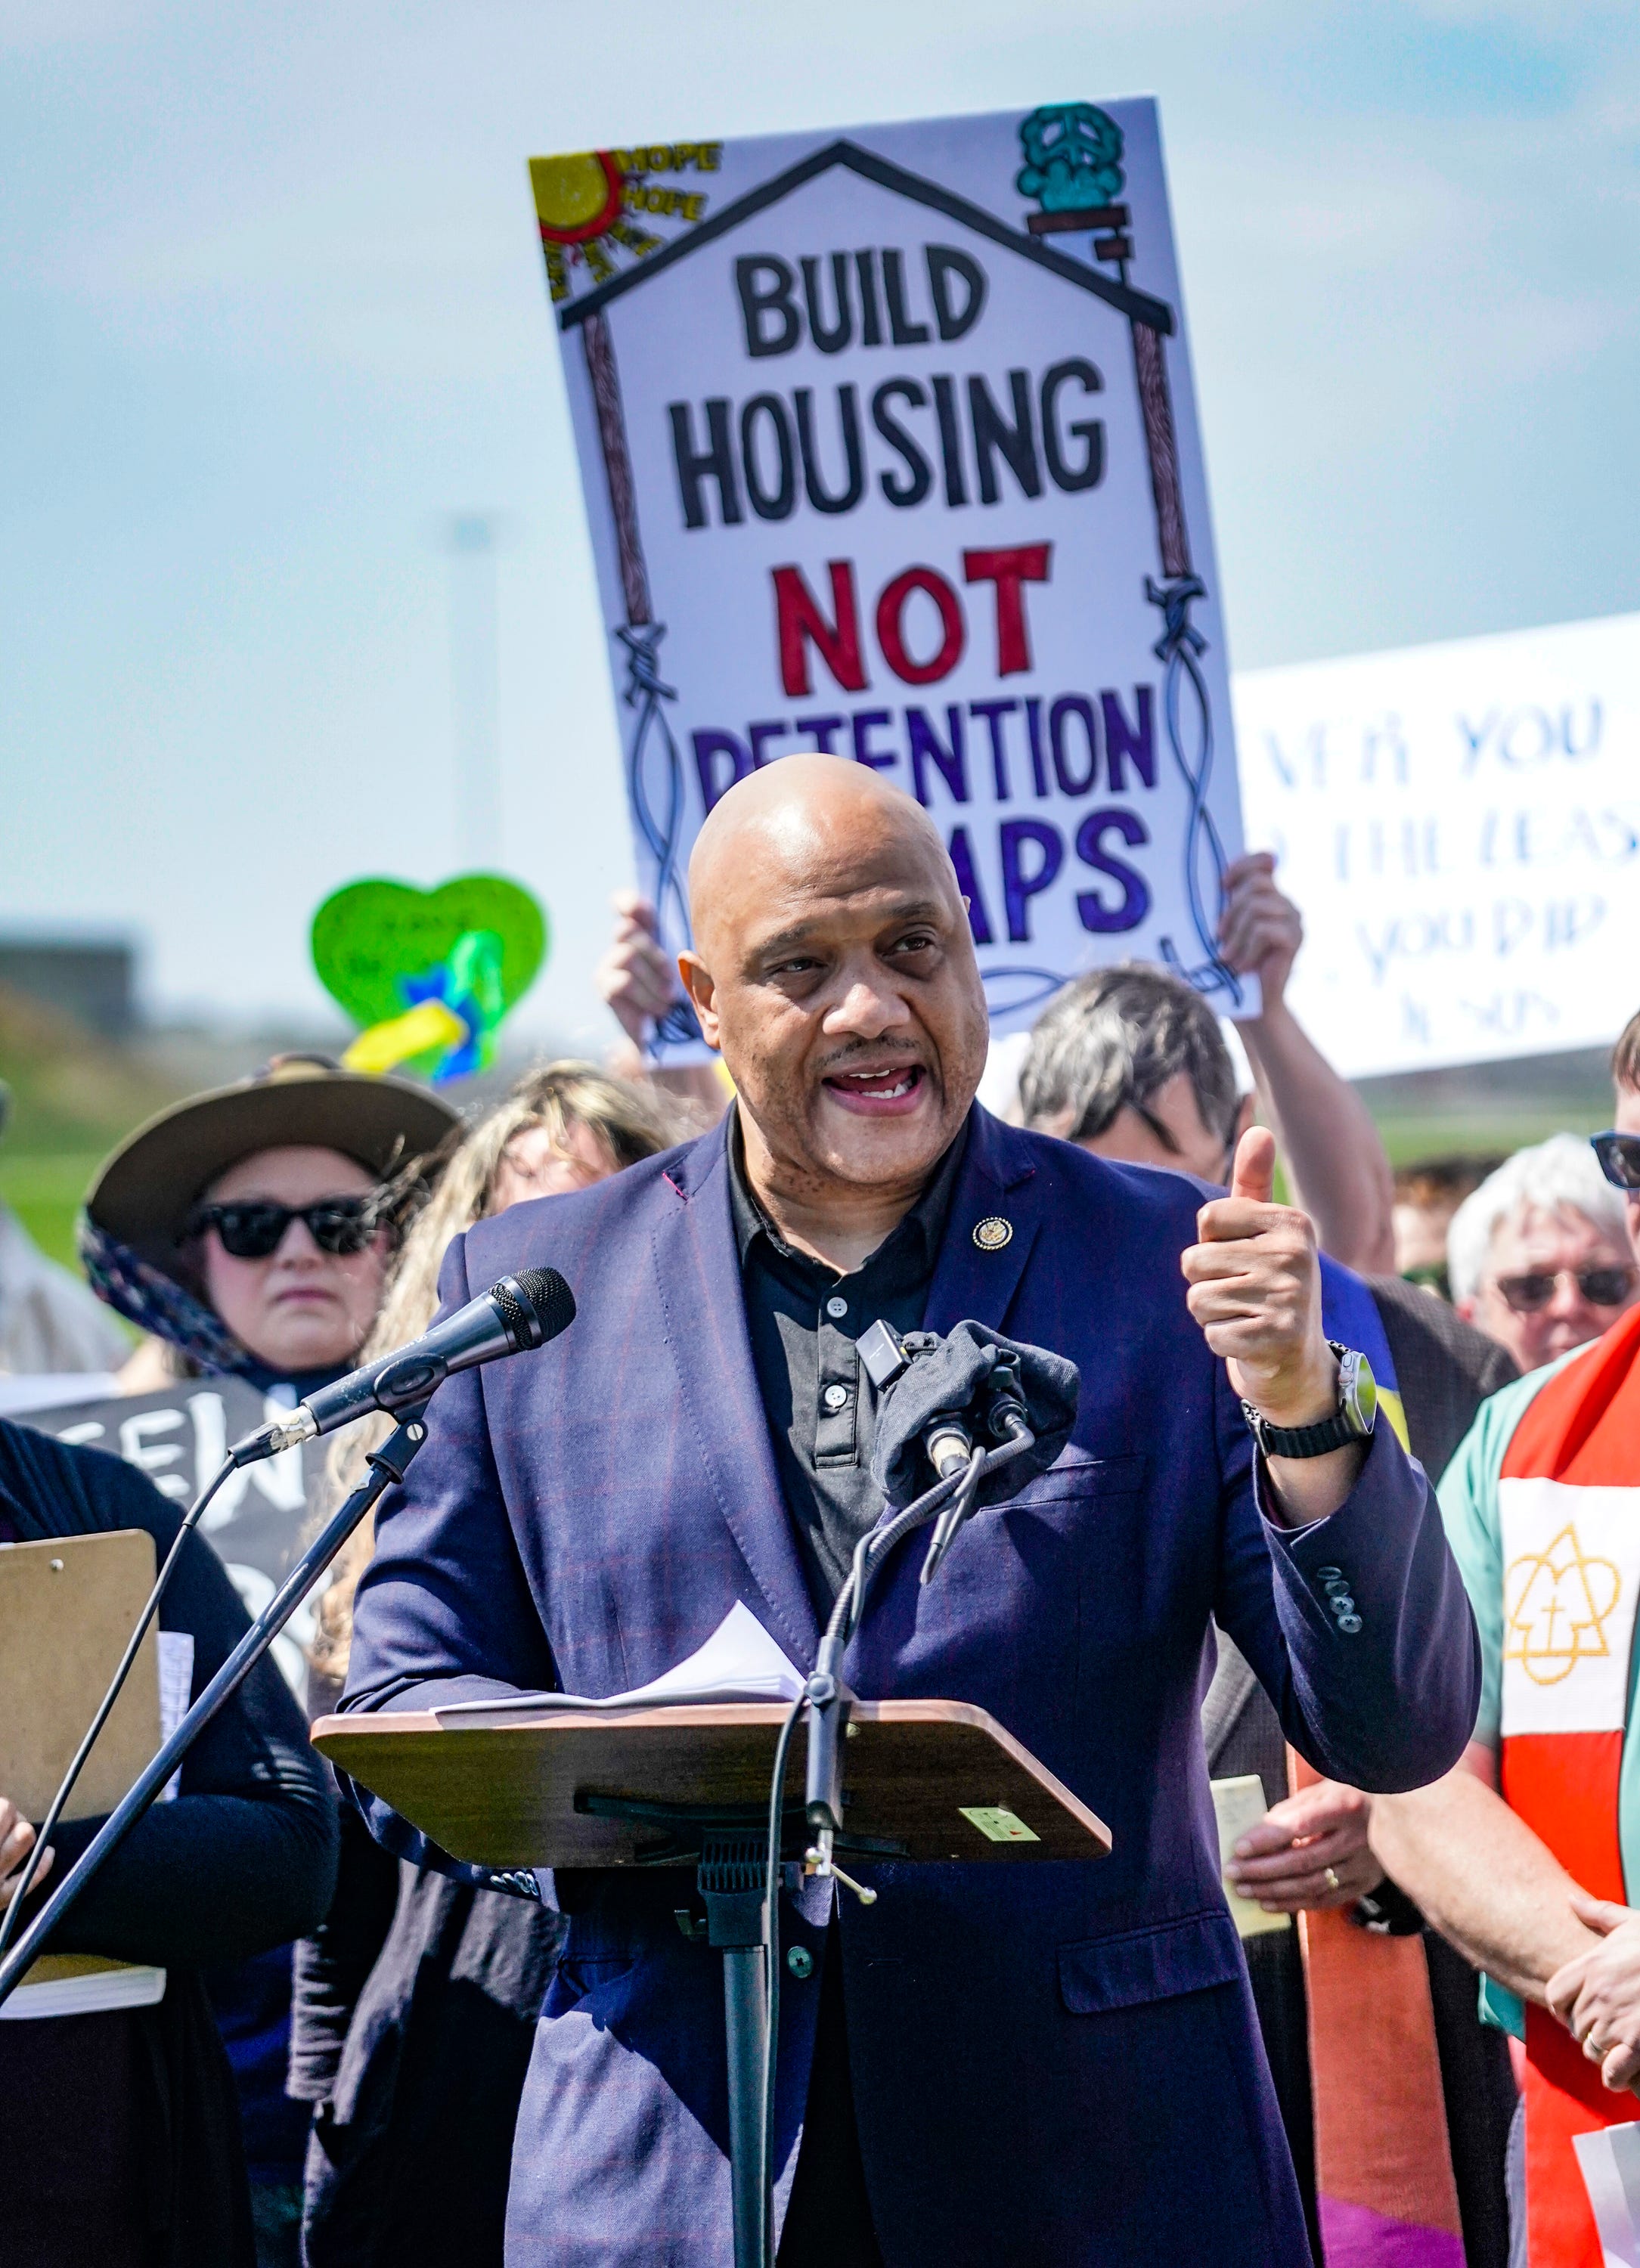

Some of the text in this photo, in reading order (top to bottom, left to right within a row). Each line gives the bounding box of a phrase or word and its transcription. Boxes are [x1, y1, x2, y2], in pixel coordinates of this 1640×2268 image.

[733, 243, 987, 358] BUILD
[667, 355, 1106, 531] HOUSING
[771, 541, 1054, 699] NOT
[1452, 692, 1604, 780] YOU
